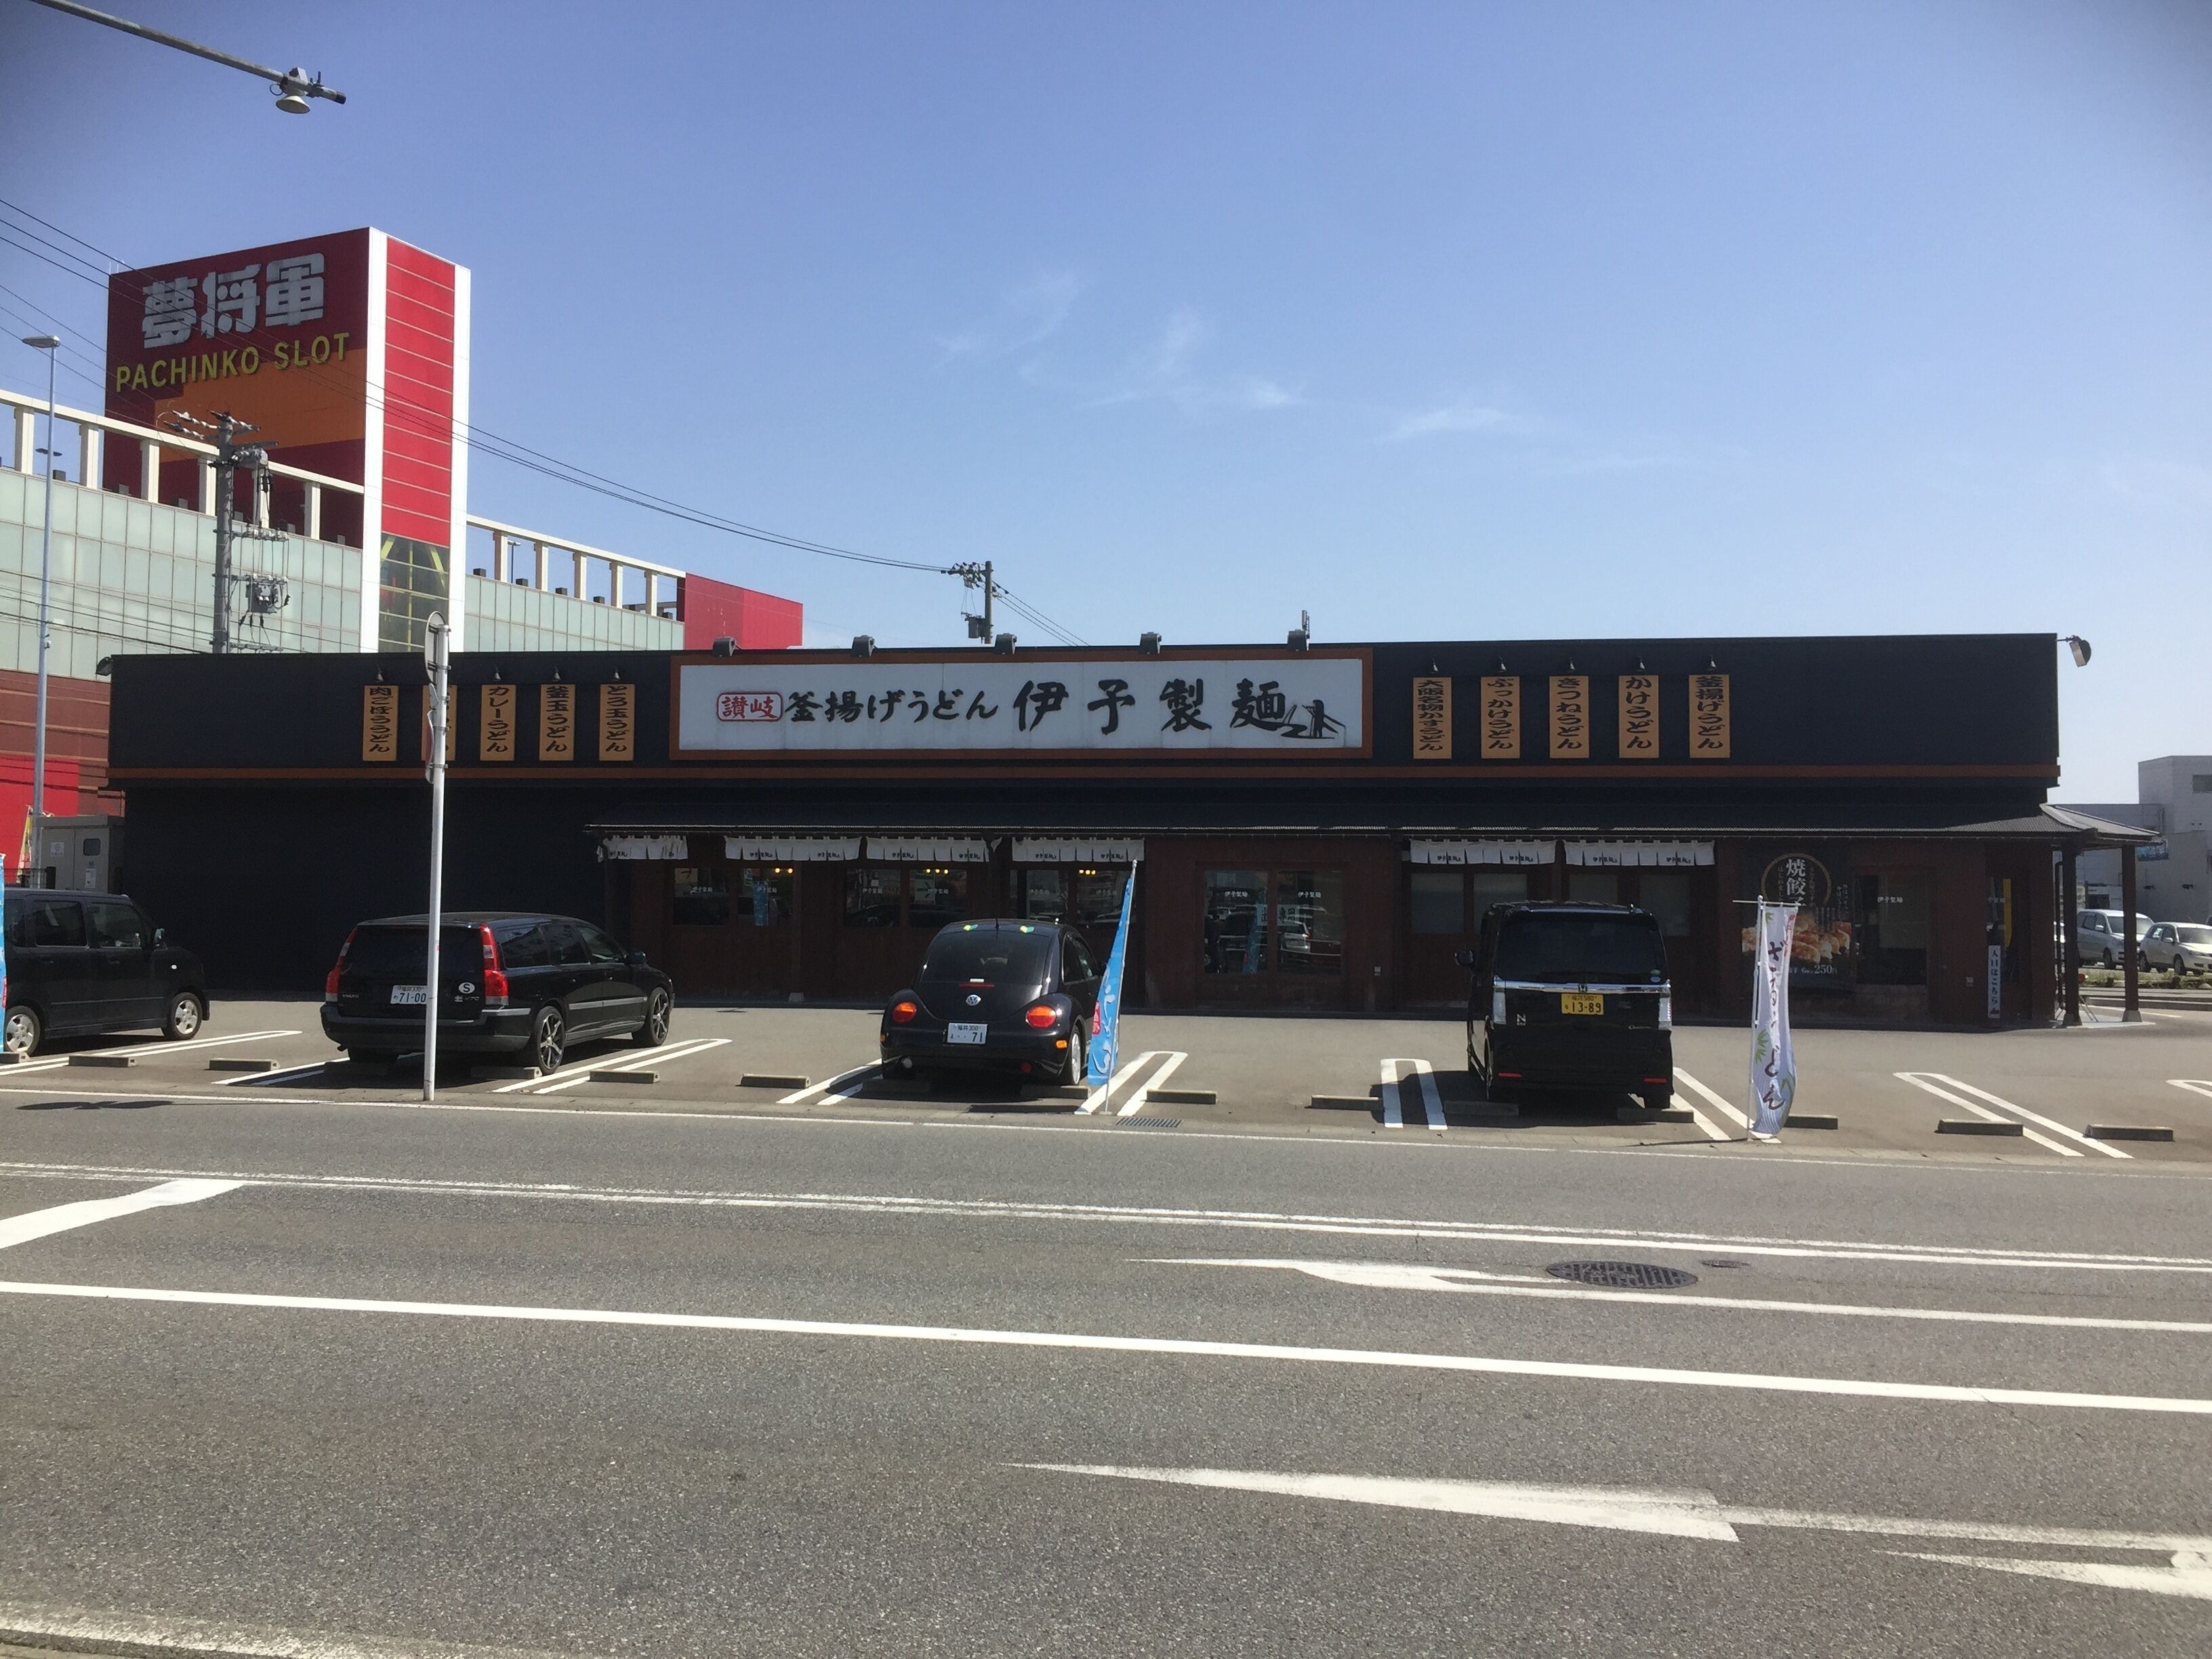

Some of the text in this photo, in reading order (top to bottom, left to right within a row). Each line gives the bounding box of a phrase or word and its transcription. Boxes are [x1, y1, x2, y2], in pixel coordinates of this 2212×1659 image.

[142, 253, 325, 349] 夢将軍
[116, 332, 350, 393] PACHINKO SLOT
[369, 687, 393, 752] 肉ごぼううどん
[487, 687, 510, 752] カレーうどん
[546, 686, 571, 752] 釜玉うどん
[605, 686, 630, 752] とろ玉うどん
[784, 689, 998, 723] 釜揚げうどん
[1013, 678, 1287, 735] 伊予製麺
[1417, 680, 1445, 751] 大阪名物かすうどん
[1487, 678, 1514, 750] ぶっかけうどん
[1557, 678, 1584, 749] きつねうどん
[1626, 677, 1654, 749] かけうどん
[1696, 676, 1725, 749] 釜揚げうどん
[399, 992, 426, 1002] 71-00
[463, 983, 470, 993] S
[1572, 1002, 1601, 1013] 13-89
